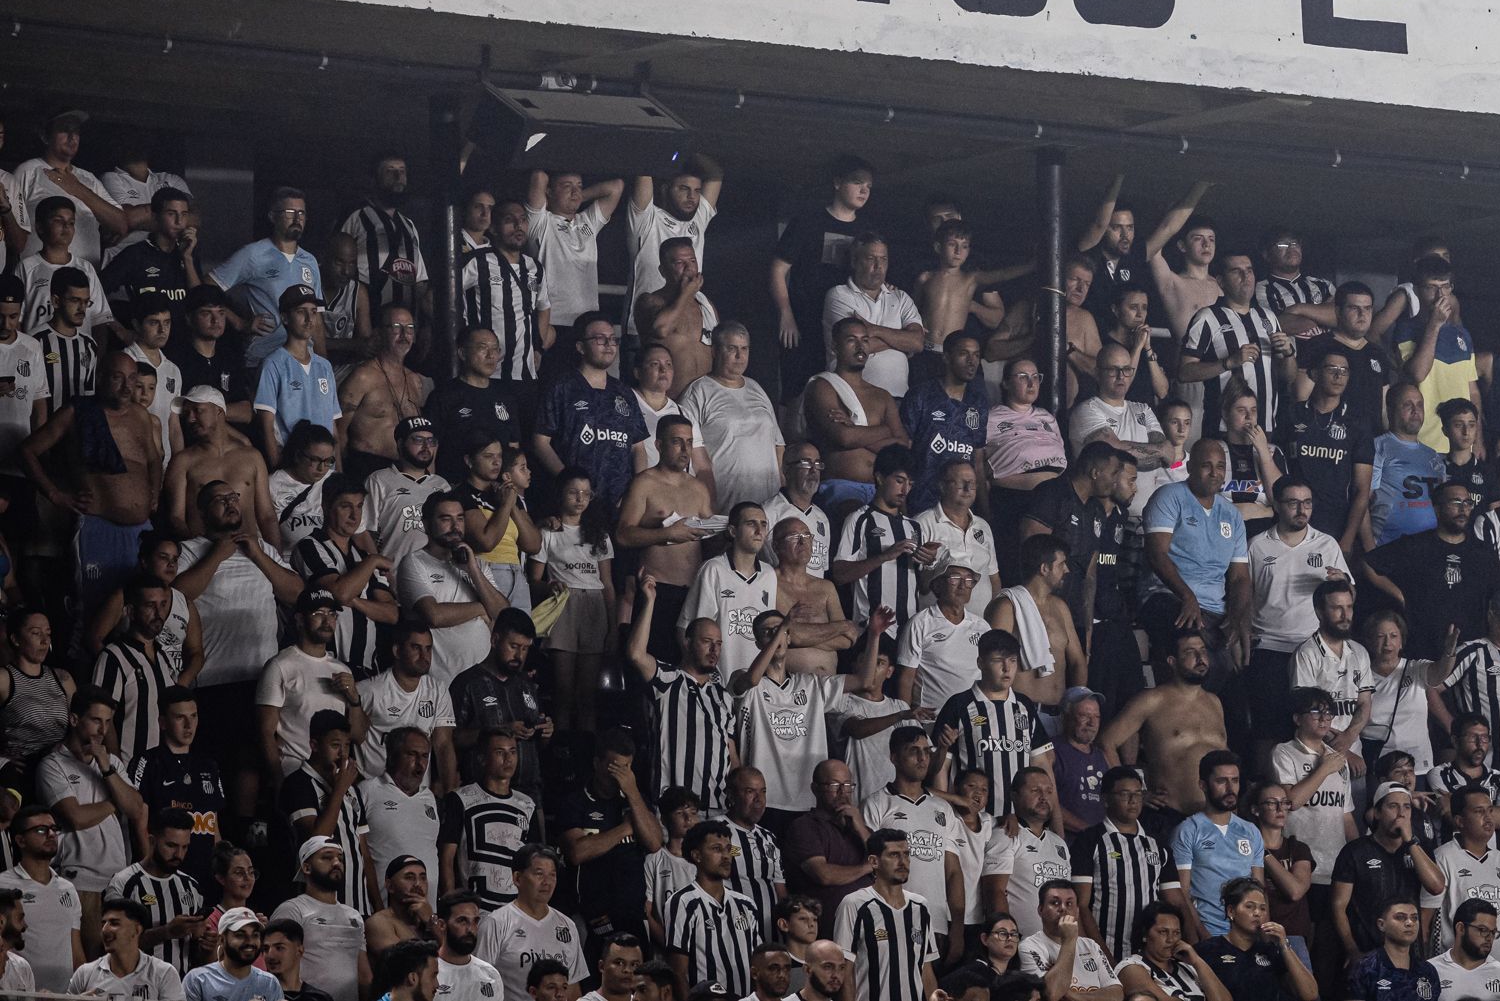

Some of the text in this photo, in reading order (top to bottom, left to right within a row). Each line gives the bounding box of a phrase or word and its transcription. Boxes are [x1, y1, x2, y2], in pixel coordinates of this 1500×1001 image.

[597, 428, 629, 443] blaze
[947, 440, 974, 455] blaze
[1300, 444, 1346, 465] sumup
[978, 734, 1033, 759] pixbet
[1032, 862, 1069, 878] Charlie
